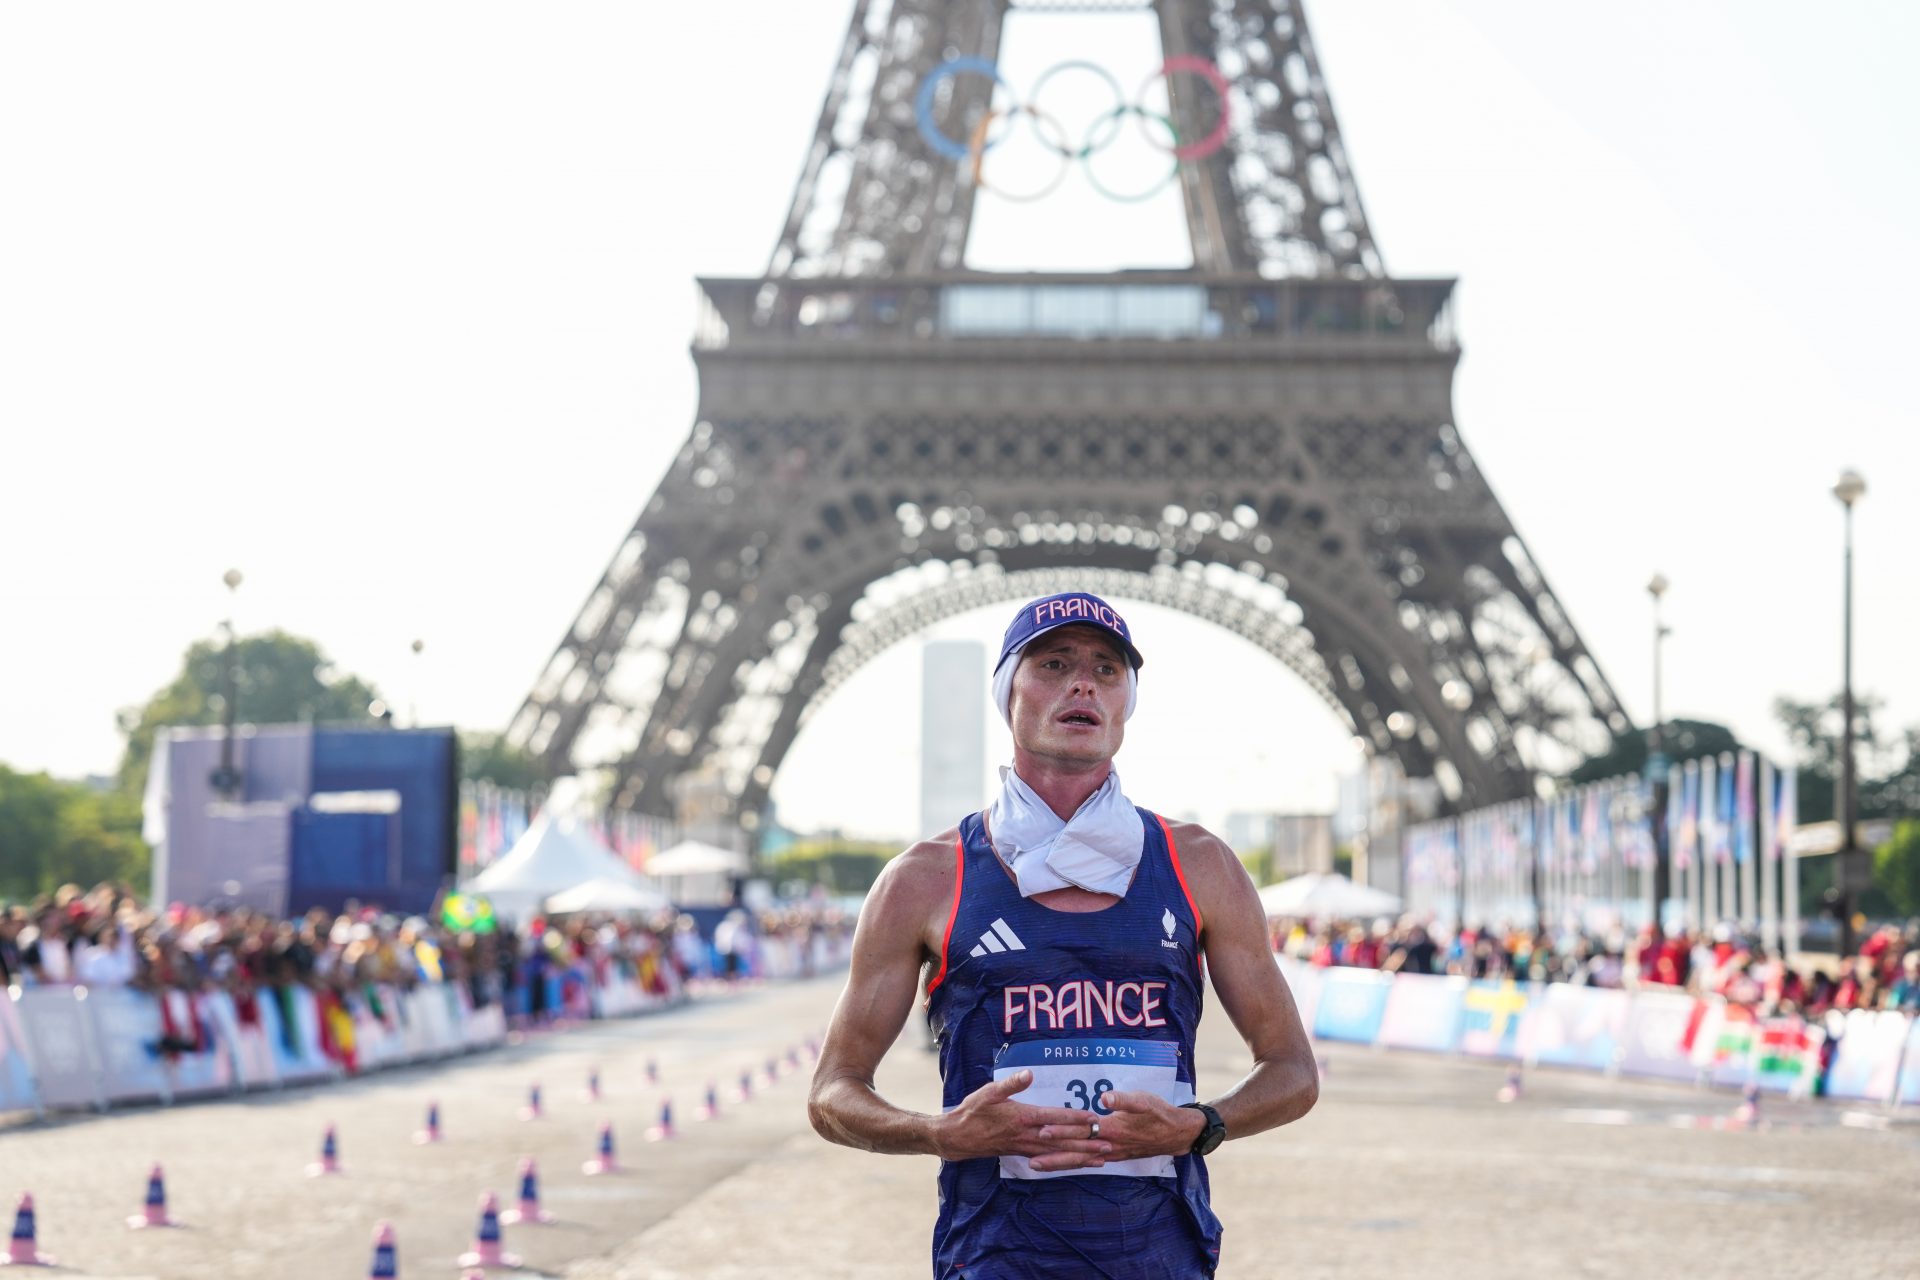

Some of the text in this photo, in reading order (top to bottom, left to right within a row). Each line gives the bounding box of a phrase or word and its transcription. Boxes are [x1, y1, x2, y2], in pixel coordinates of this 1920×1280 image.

[1035, 598, 1124, 636] FRANCE
[1003, 981, 1168, 1033] FRANCE
[1095, 1046, 1136, 1058] 2024
[1064, 1078, 1114, 1116] 38
